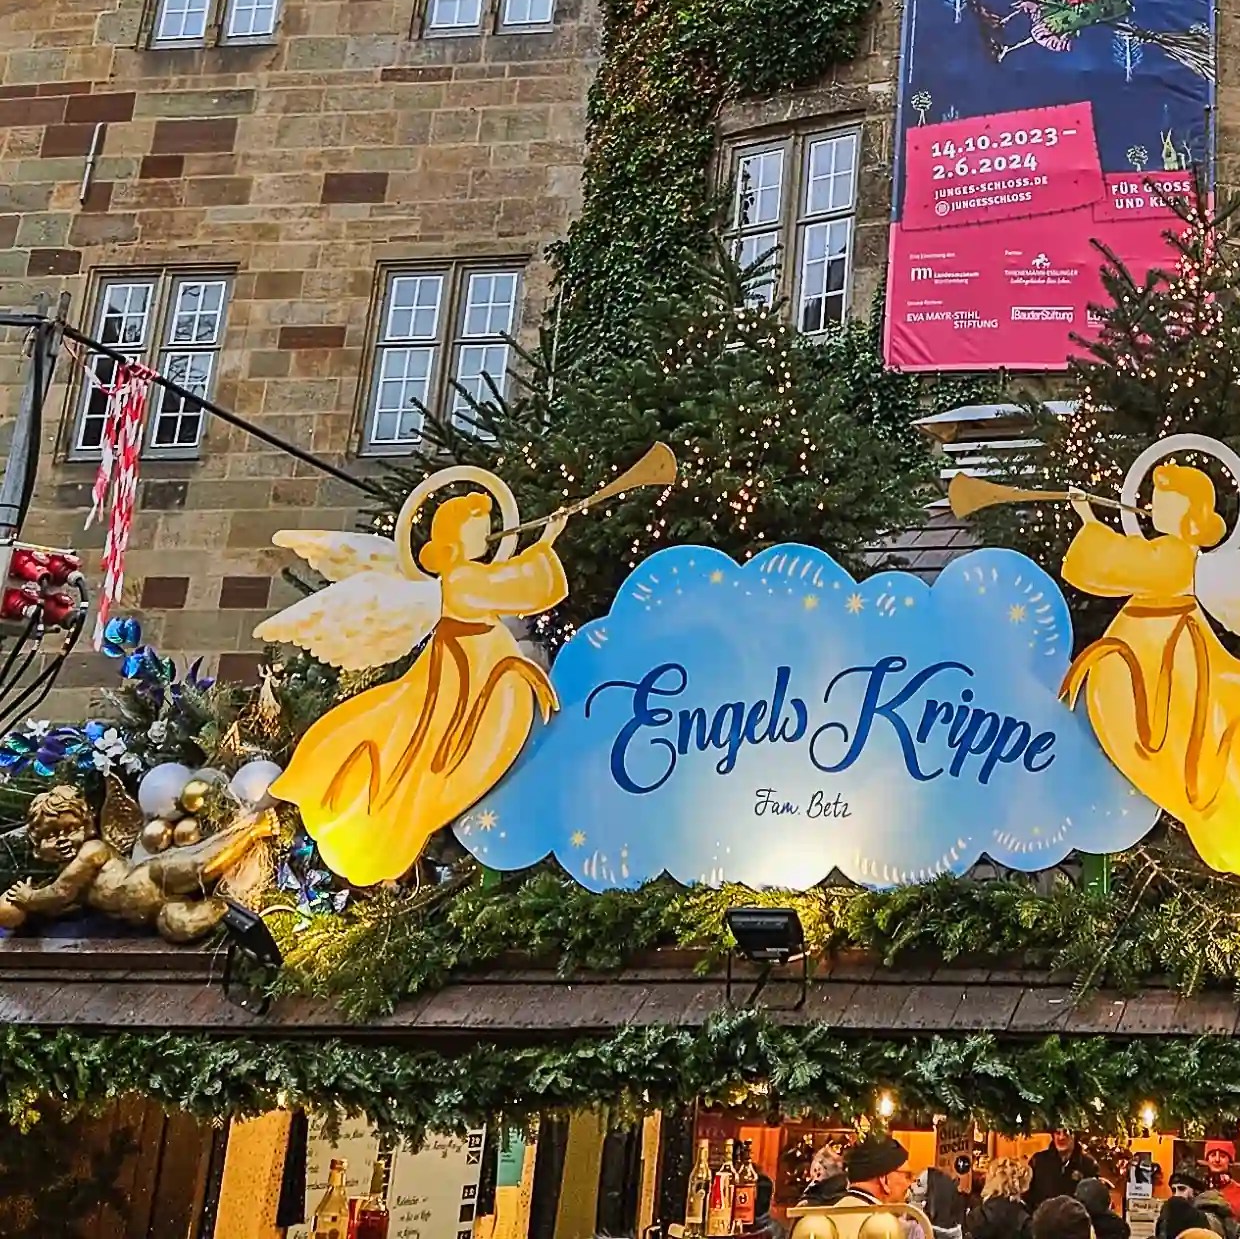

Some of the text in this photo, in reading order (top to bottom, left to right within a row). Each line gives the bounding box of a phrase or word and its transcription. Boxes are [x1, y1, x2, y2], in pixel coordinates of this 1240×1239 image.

[933, 153, 1038, 180] 2.6.2024
[1112, 181, 1138, 195] FÜR
[1116, 197, 1144, 209] UND
[907, 312, 924, 322] EVA
[954, 319, 999, 329] STIFTUNG
[585, 656, 1056, 794] Engels Krippe
[754, 789, 852, 818] Fam. Betz
